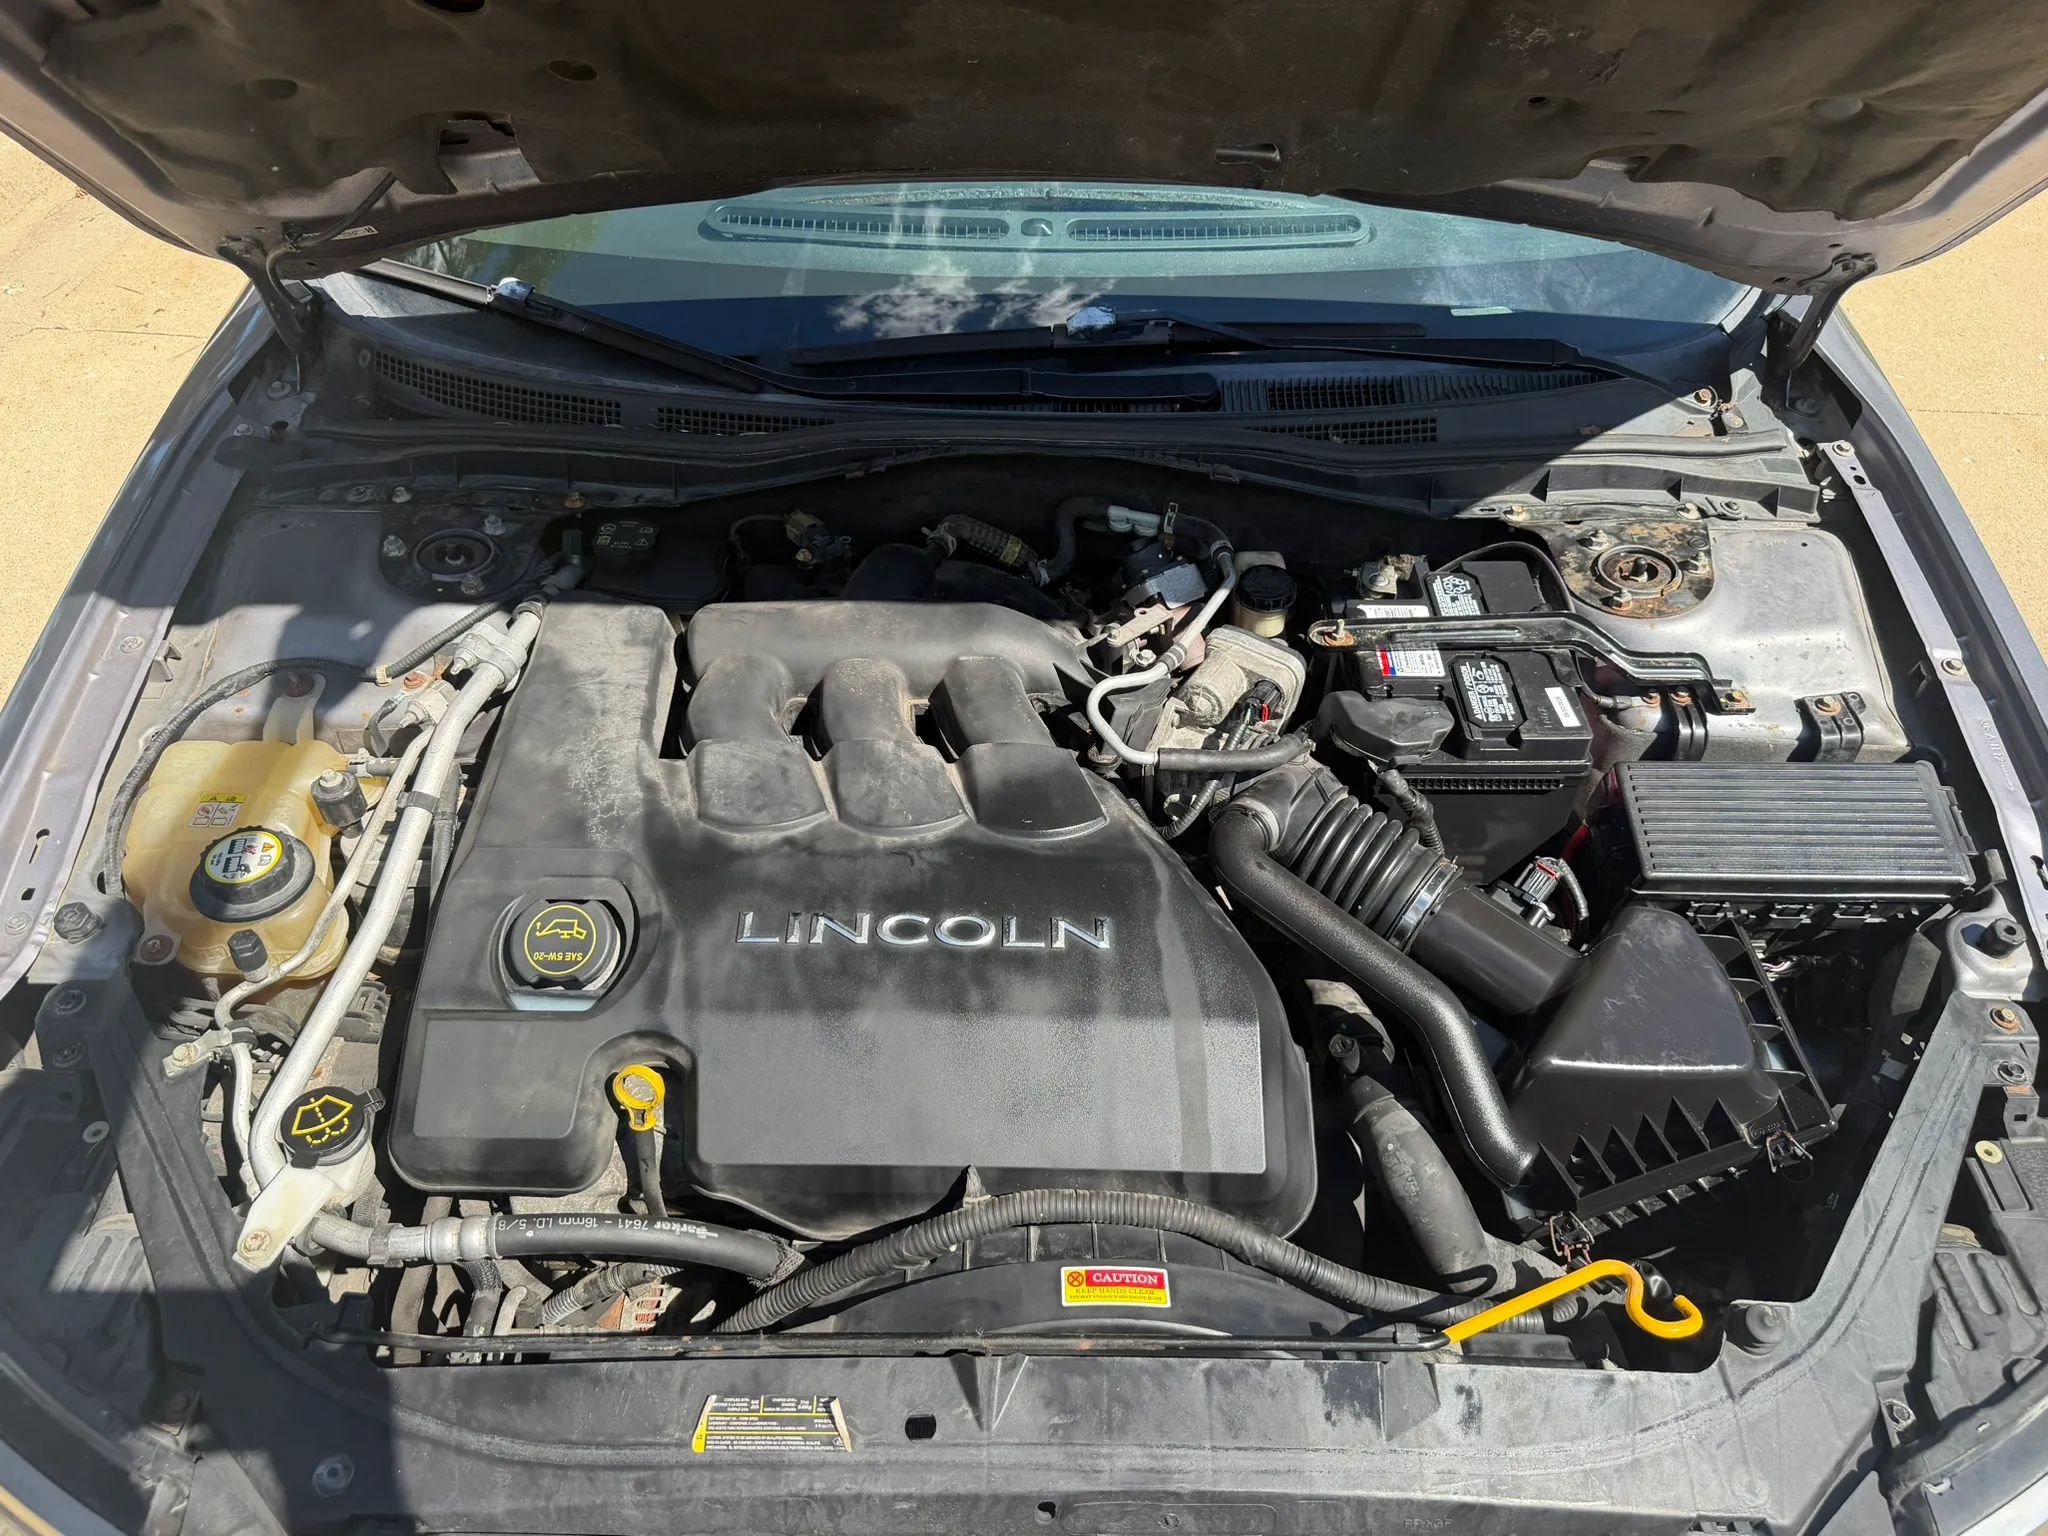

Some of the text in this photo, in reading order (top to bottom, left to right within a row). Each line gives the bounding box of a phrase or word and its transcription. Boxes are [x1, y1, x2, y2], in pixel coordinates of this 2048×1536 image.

[735, 911, 1110, 949] LINCOLN
[533, 951, 583, 961] SAE 5W-20
[532, 1216, 553, 1229] I.D.
[558, 1216, 598, 1228] 16mm
[617, 1217, 649, 1231] 7641
[654, 1218, 718, 1239] Parker
[1092, 1272, 1158, 1285] CAUTION
[1075, 1287, 1155, 1296] KEEP HANDS CLEAR
